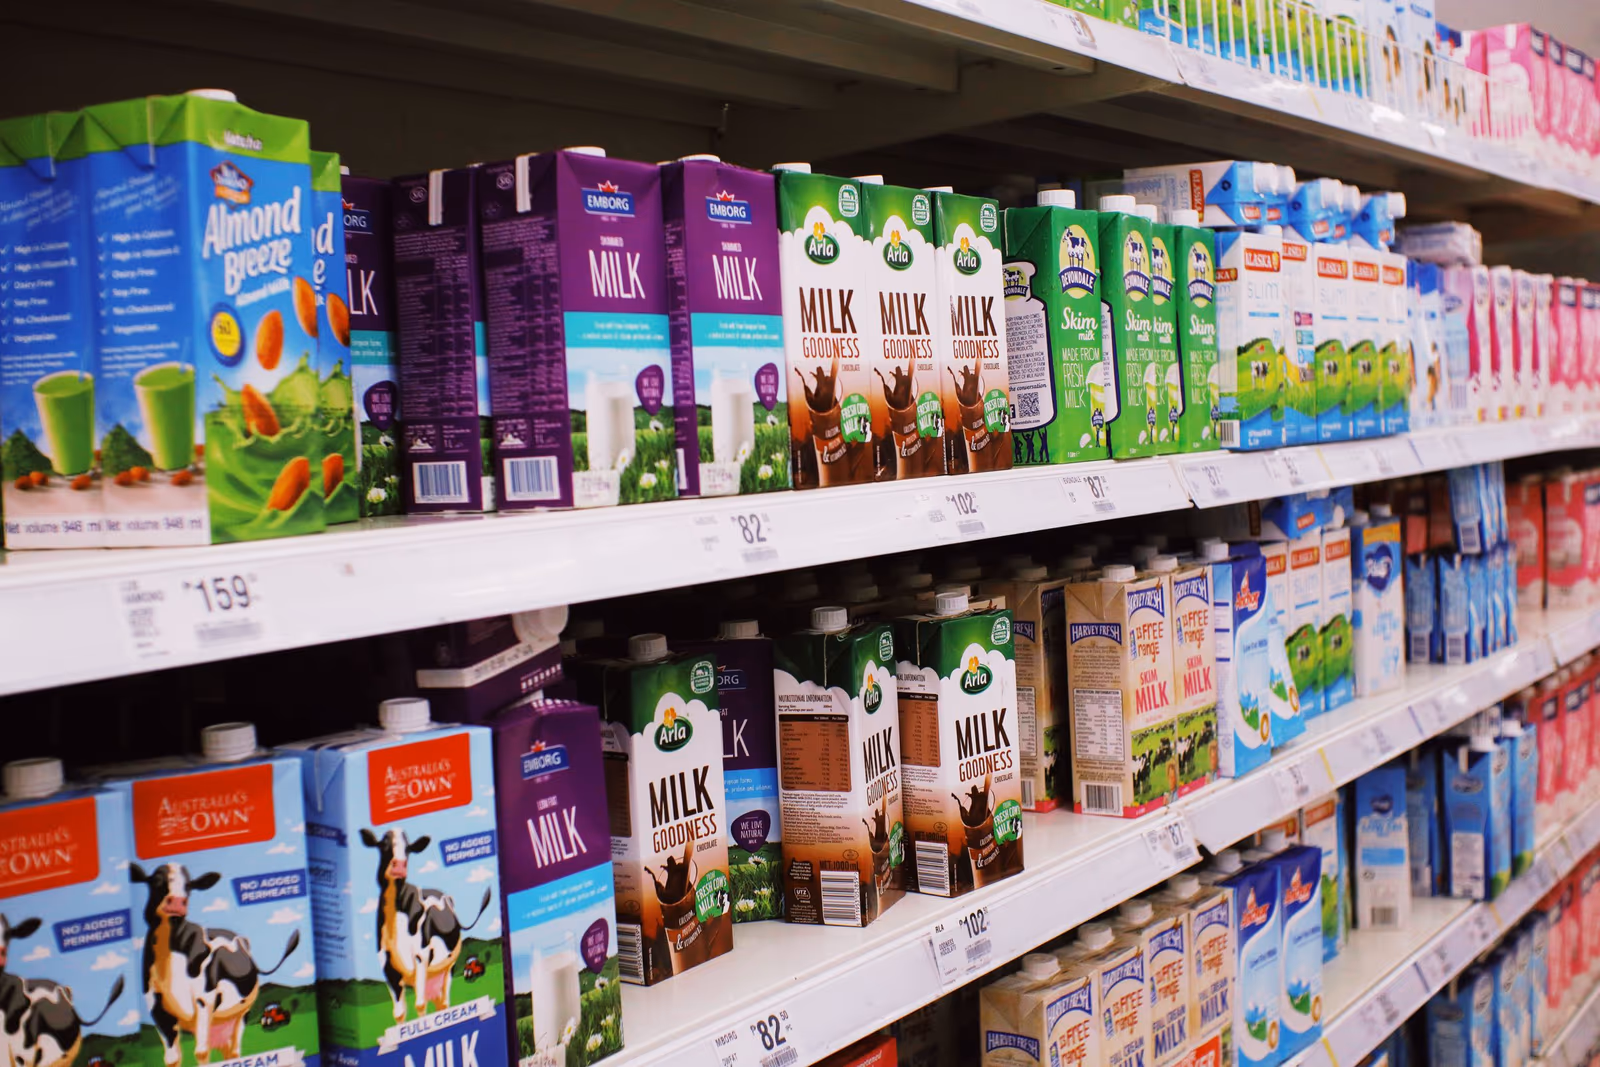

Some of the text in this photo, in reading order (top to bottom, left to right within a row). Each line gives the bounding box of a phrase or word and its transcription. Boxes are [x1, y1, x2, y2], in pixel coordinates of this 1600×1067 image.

[587, 194, 630, 211] EMBORG
[709, 203, 747, 218] EMBORG
[203, 185, 301, 258] Almond
[808, 238, 834, 257] Arla
[887, 246, 909, 264] Arla
[224, 238, 292, 296] Breeze
[957, 252, 977, 268] Arla
[1245, 251, 1272, 267] ALASKA
[589, 249, 646, 299] MILK
[712, 255, 763, 301] MILK
[1061, 271, 1096, 290] DEVONDALE
[347, 269, 378, 315] LK
[799, 286, 857, 334] MILK
[879, 291, 931, 335] MILK
[949, 295, 997, 336] MILK
[1061, 306, 1099, 331] Skim
[1125, 308, 1152, 332] Skim
[1153, 314, 1174, 335] kim
[1189, 313, 1216, 337] Skim
[1078, 330, 1095, 341] milk
[1137, 331, 1149, 341] milk
[802, 337, 860, 358] GOODNESS
[883, 339, 933, 359] GOODNESS
[953, 339, 999, 359] GOODNESS
[1062, 347, 1101, 360] MADE FROM
[1126, 348, 1139, 360] MADE
[1063, 363, 1085, 386] FRESH
[1126, 363, 1141, 386] FRESH
[1064, 389, 1086, 408] MILK
[1127, 389, 1144, 406] MILK
[843, 418, 859, 434] MILK
[919, 415, 931, 430] MILK
[986, 413, 998, 426] MILK
[1087, 476, 1105, 498] 87
[738, 513, 767, 544] 82
[193, 575, 250, 612] 159
[1146, 588, 1162, 612] FRESH
[1013, 623, 1034, 639] FRESH
[1072, 624, 1120, 641] HARVEY FRESH
[1184, 629, 1205, 649] range
[1138, 642, 1159, 663] range
[1187, 655, 1203, 670] SKIM
[717, 674, 739, 685] ORG
[964, 669, 987, 688] Arla
[1140, 668, 1158, 685] SKIM
[1184, 666, 1212, 699] MILK
[866, 692, 879, 708] Arla
[1135, 681, 1169, 715] MILK
[659, 725, 686, 745] Arla
[722, 718, 750, 758] LK
[955, 707, 1011, 760] MILK
[523, 751, 562, 774] EMBORG
[863, 726, 896, 783] MILK
[384, 759, 452, 783] AUSTRALIA'S
[959, 750, 1013, 782] GOODNESS
[867, 770, 898, 806] GOODNESS
[994, 773, 1013, 783] CHOCOLATE
[406, 778, 453, 800] OWN
[649, 765, 714, 829] MILK
[157, 791, 248, 816] AUSTRALIA'S
[190, 811, 250, 832] OWN
[750, 820, 763, 829] LOVE
[993, 811, 1009, 826] FRESH
[527, 806, 588, 869] MILK
[653, 813, 717, 854] GOODNESS
[740, 828, 763, 838] NATURAL
[996, 825, 1011, 839] MILK
[1169, 822, 1184, 845] 87
[444, 835, 492, 853] NO ADDED
[696, 839, 718, 853] CHOCOLATE
[9, 848, 72, 876] OWN
[446, 846, 492, 864] PERMEATE
[240, 873, 299, 892] NO ADDED
[240, 884, 300, 902] PERMEATE
[695, 876, 727, 901] FRESH COW'S
[698, 897, 715, 916] MILK
[62, 916, 124, 937] NO ADDED
[63, 927, 125, 949] PERMEATE
[1200, 988, 1229, 1028] MILK
[400, 1003, 478, 1039] FULL CREAM
[715, 1031, 738, 1048] MBORG
[779, 1010, 789, 1021] 50
[987, 1032, 1039, 1059] HARVEY FRESH
[1154, 1016, 1187, 1059] MILK
